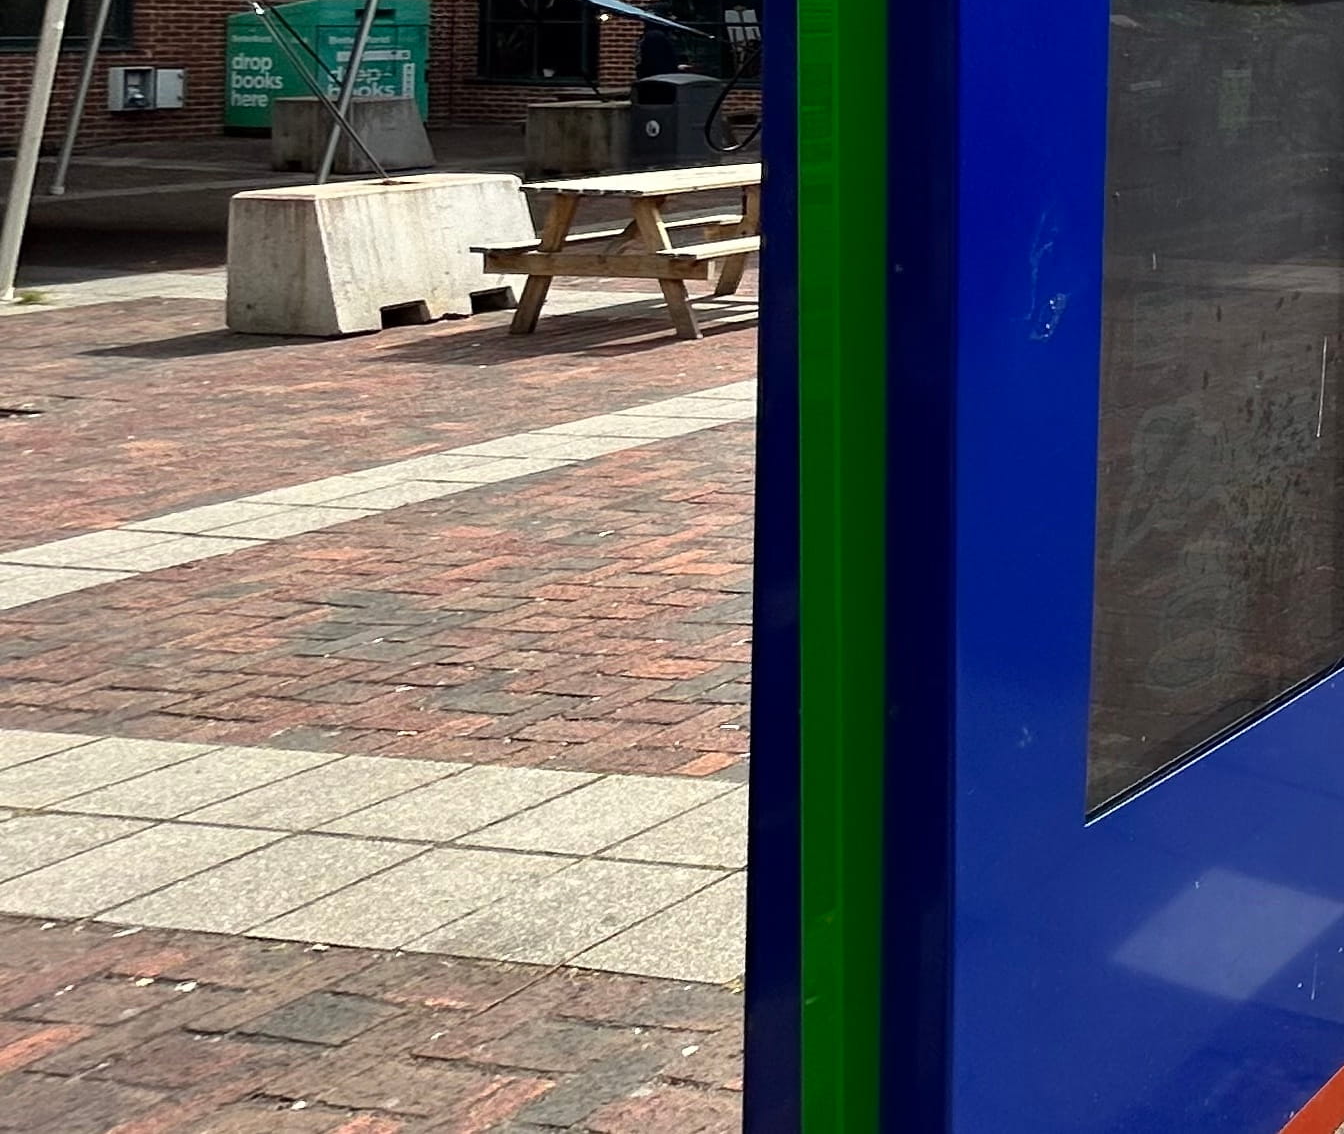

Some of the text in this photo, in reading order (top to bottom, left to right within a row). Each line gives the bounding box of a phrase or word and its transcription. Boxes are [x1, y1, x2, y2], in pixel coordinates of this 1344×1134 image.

[231, 53, 273, 74] drop
[231, 71, 283, 89] books
[231, 90, 268, 107] here
